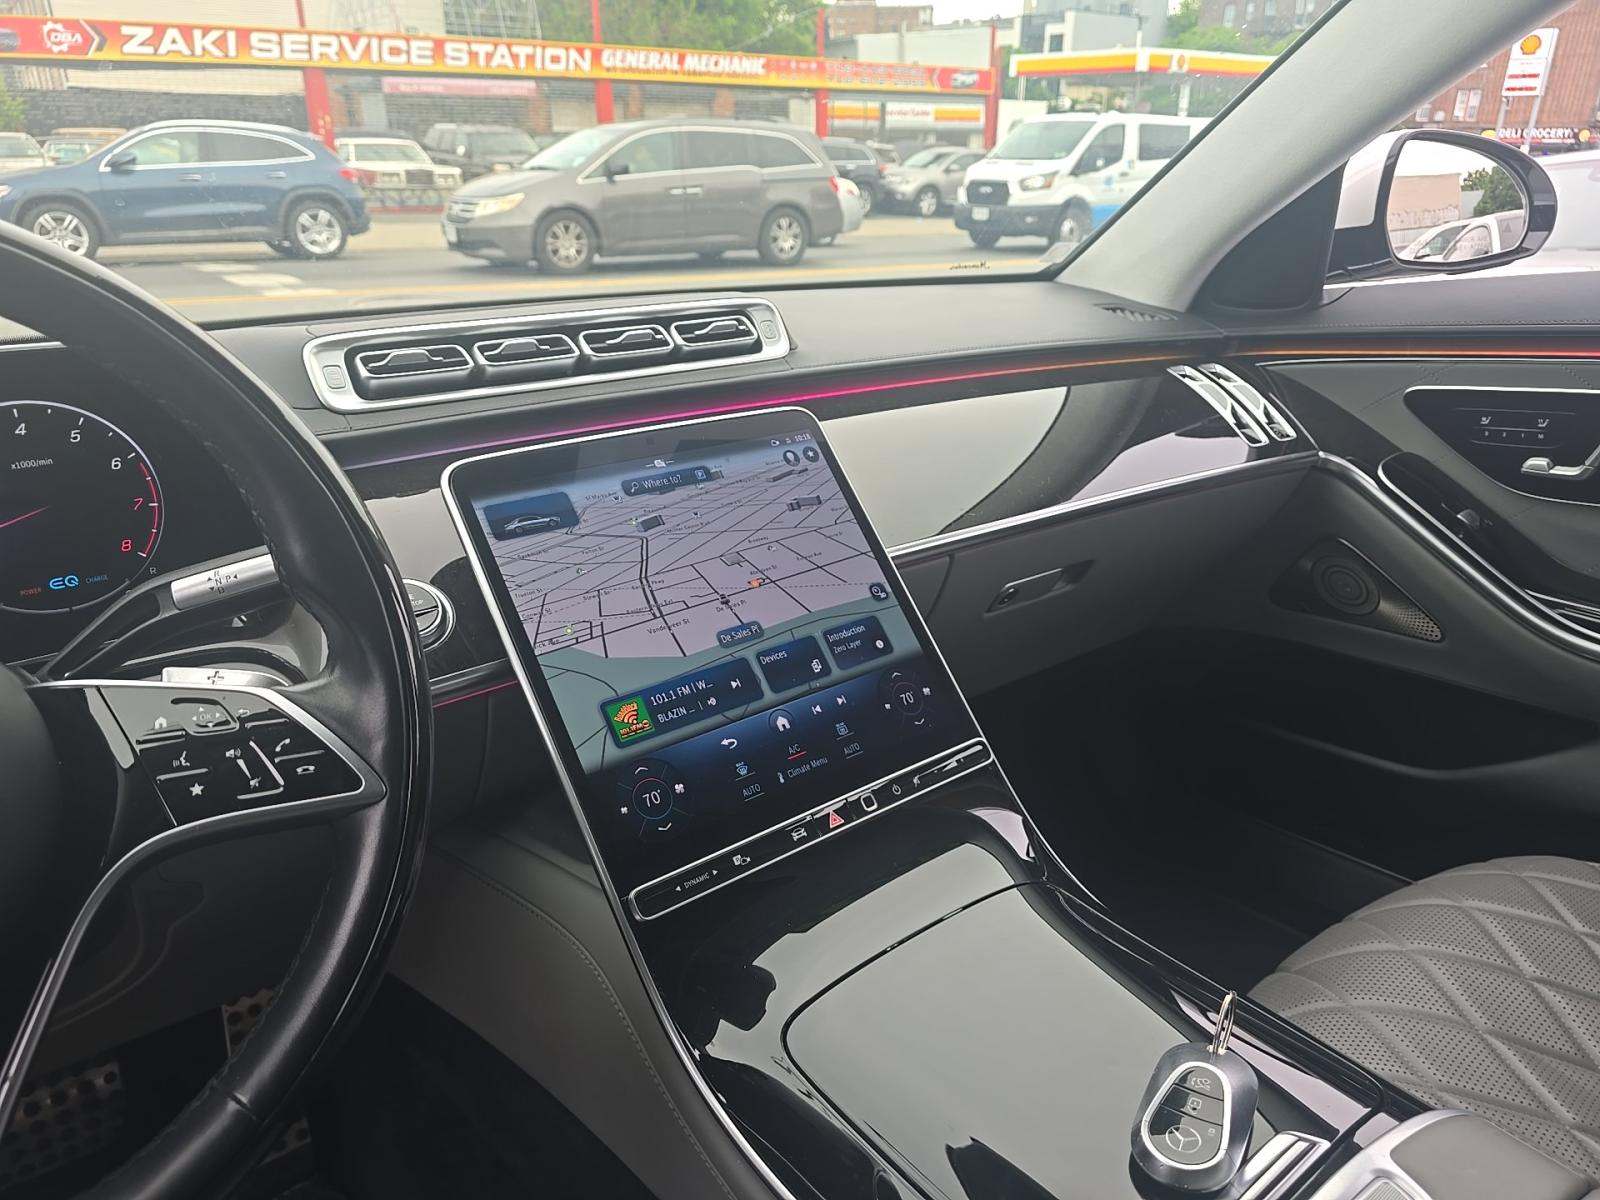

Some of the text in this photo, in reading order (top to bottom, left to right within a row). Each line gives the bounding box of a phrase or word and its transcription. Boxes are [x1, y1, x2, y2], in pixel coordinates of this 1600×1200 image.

[120, 25, 236, 57] ZAKI
[250, 31, 434, 66] SERVICE
[444, 40, 592, 71] STATION
[601, 48, 681, 70] GENERAL
[683, 54, 767, 75] MECHANIC
[15, 423, 27, 435] 4
[70, 430, 81, 443] 5
[11, 458, 54, 470] x1000/min
[111, 457, 122, 470] 6
[642, 475, 682, 489] Where to?
[134, 497, 144, 511] 7
[121, 539, 132, 552] 8
[49, 574, 79, 590] EQ
[214, 577, 222, 586] N
[225, 574, 231, 583] P
[217, 586, 225, 594] D
[721, 635, 732, 643] De
[732, 628, 752, 639] Sales
[827, 624, 866, 642] Introduction
[833, 639, 862, 654] Zero Layer
[760, 651, 787, 665] Devices
[650, 690, 677, 706] 101.1
[676, 686, 690, 696] FM
[657, 706, 687, 723] BLAZIN
[788, 744, 801, 755] A/C
[843, 742, 860, 756] AUTO
[787, 757, 829, 778] Climate Menu
[742, 783, 761, 798] AUTO
[683, 872, 710, 889] DYNAMIC
